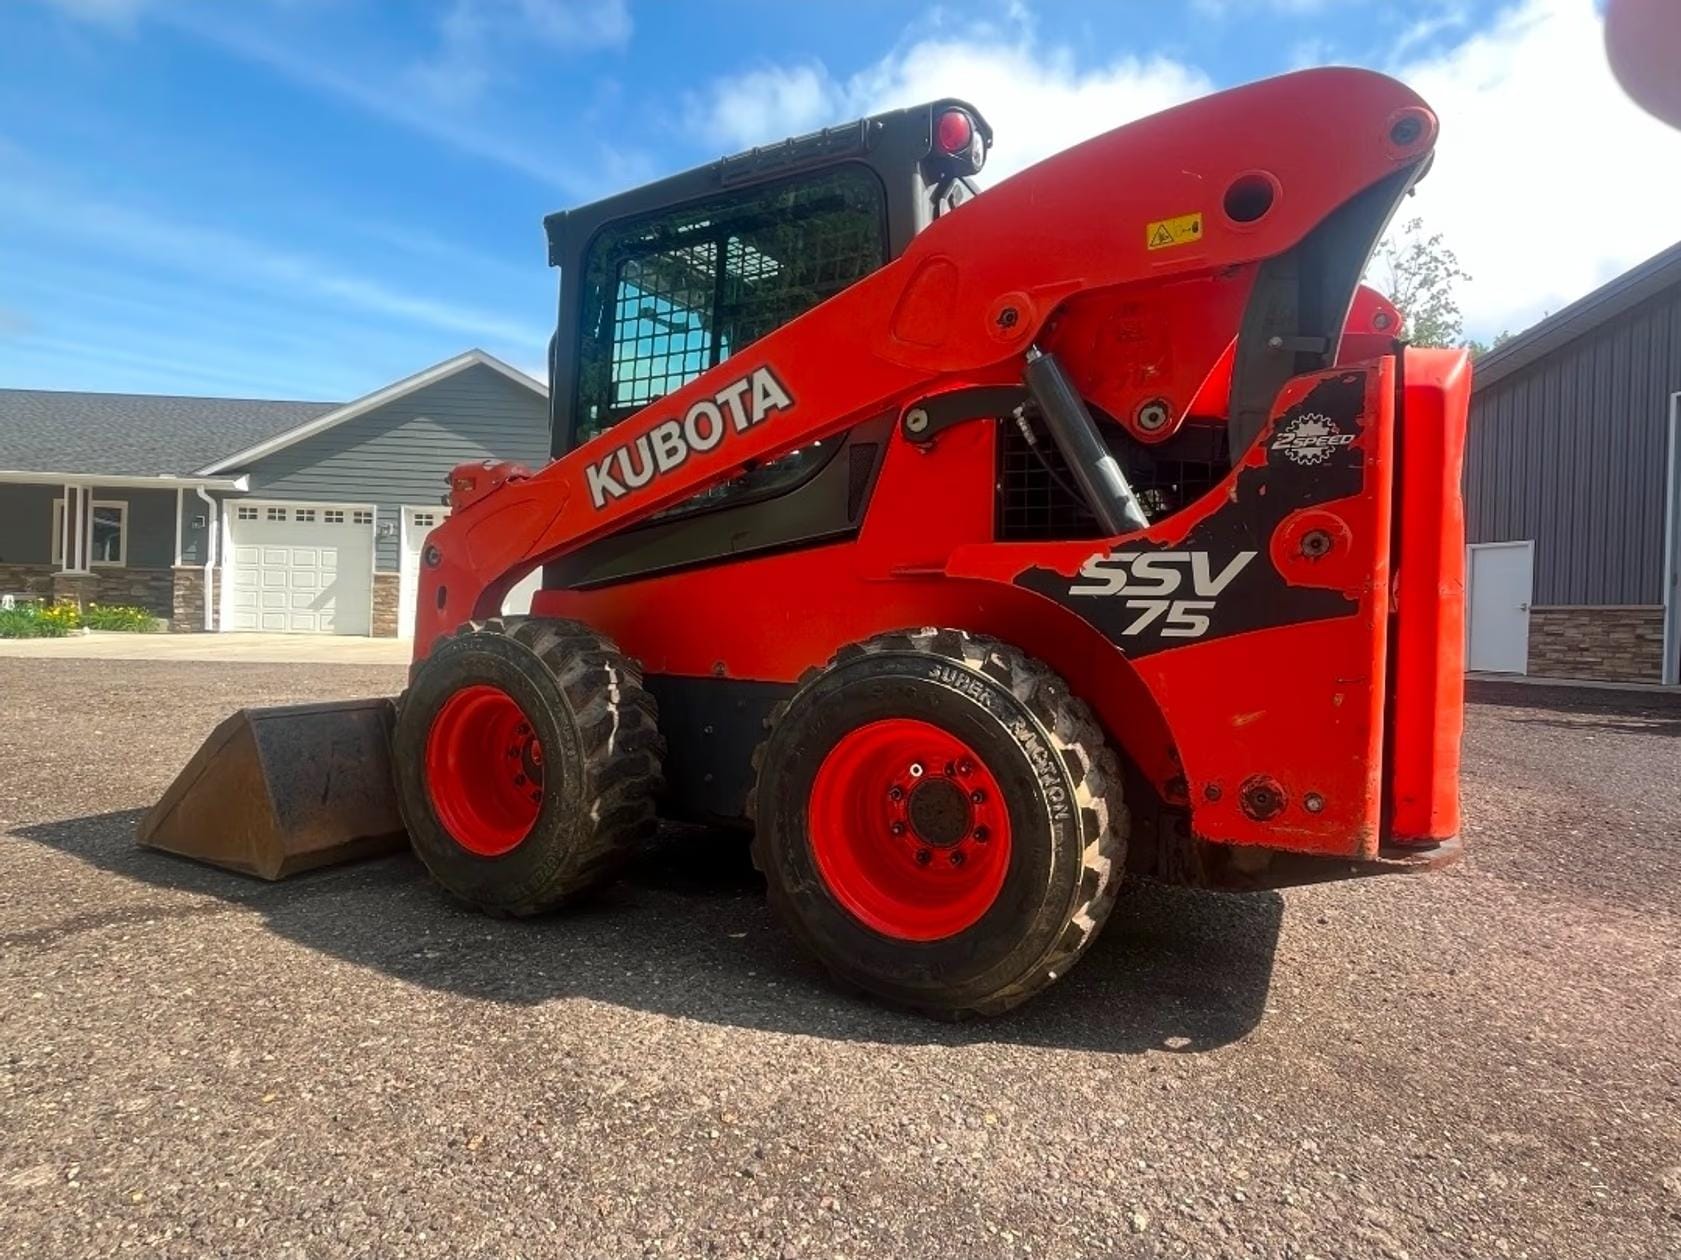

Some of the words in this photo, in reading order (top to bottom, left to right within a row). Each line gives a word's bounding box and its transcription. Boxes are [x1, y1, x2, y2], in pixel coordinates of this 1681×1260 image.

[584, 366, 793, 509] KUBOTA
[1068, 550, 1259, 597] SSV
[1120, 599, 1217, 638] 75
[928, 664, 997, 708] SUPER
